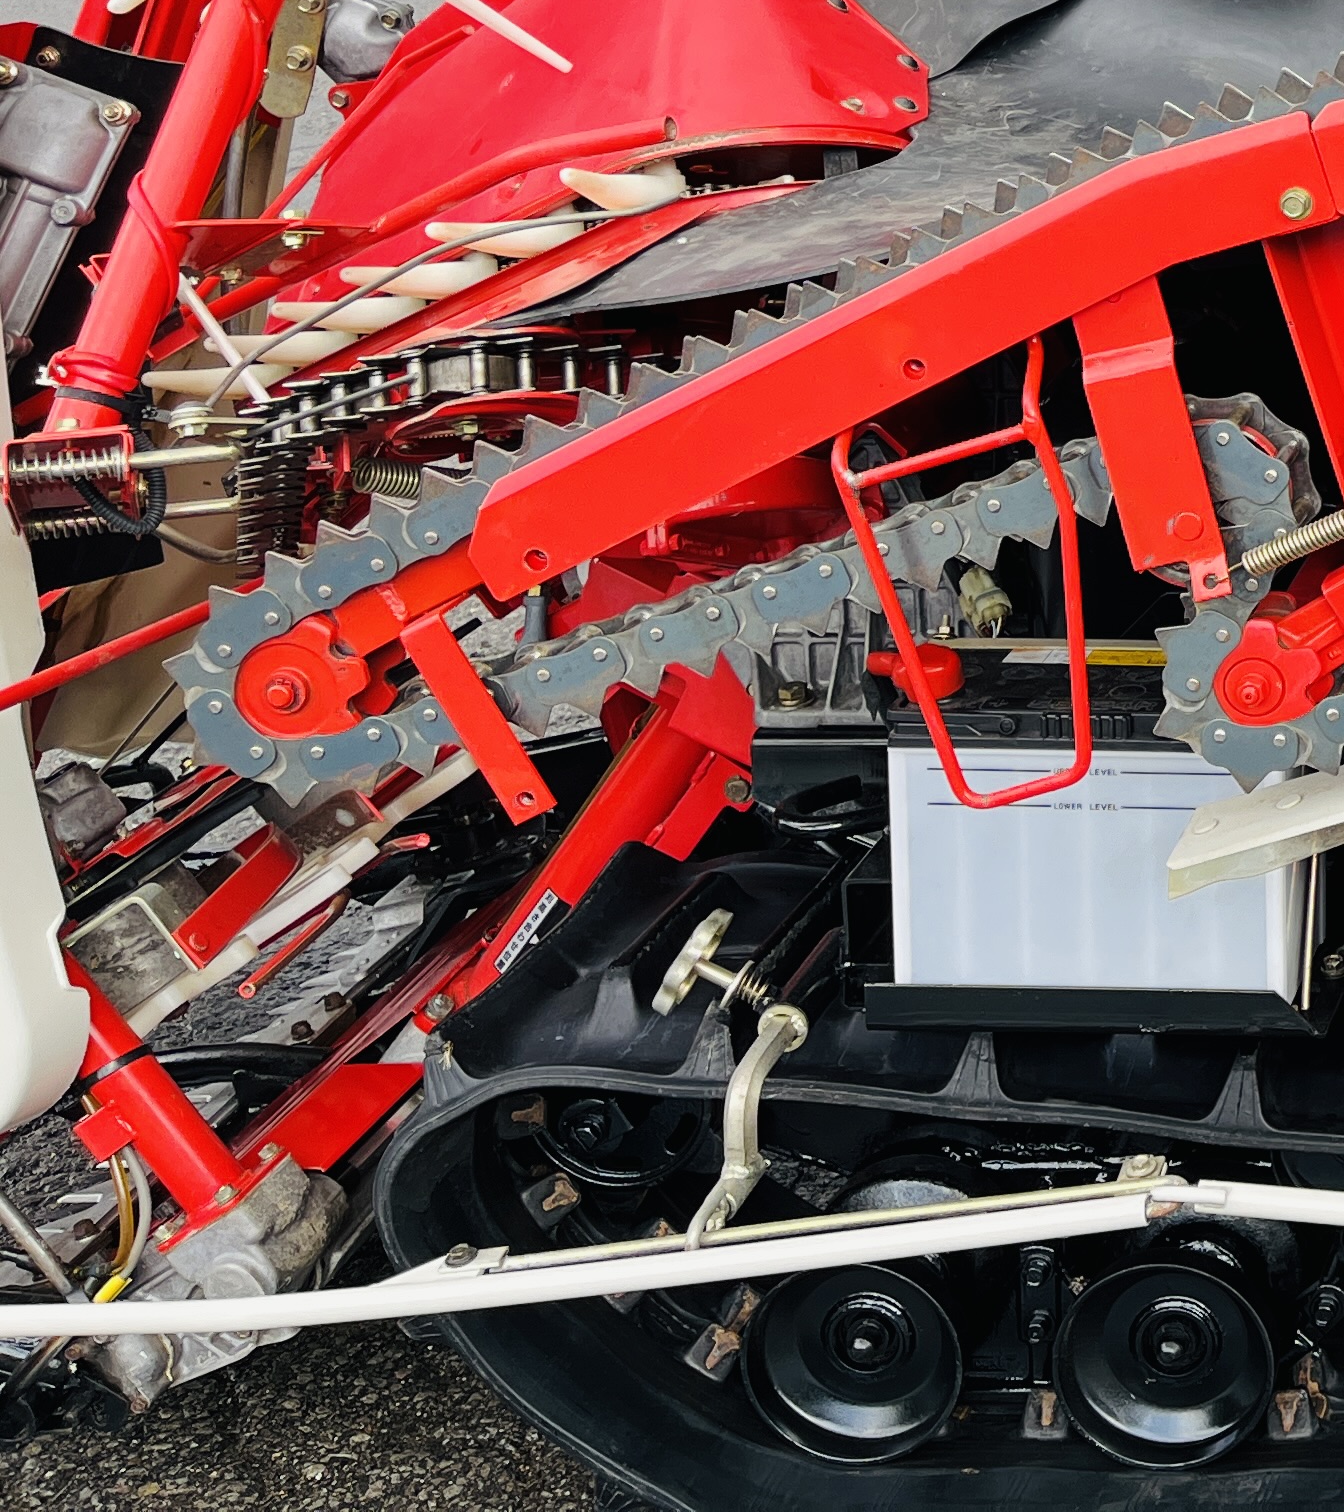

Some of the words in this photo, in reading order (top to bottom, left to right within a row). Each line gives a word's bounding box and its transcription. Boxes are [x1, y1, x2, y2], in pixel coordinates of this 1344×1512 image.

[1089, 768, 1117, 776] LEVEL
[1053, 802, 1082, 810] LOWER
[1089, 803, 1118, 811] LEVEL
